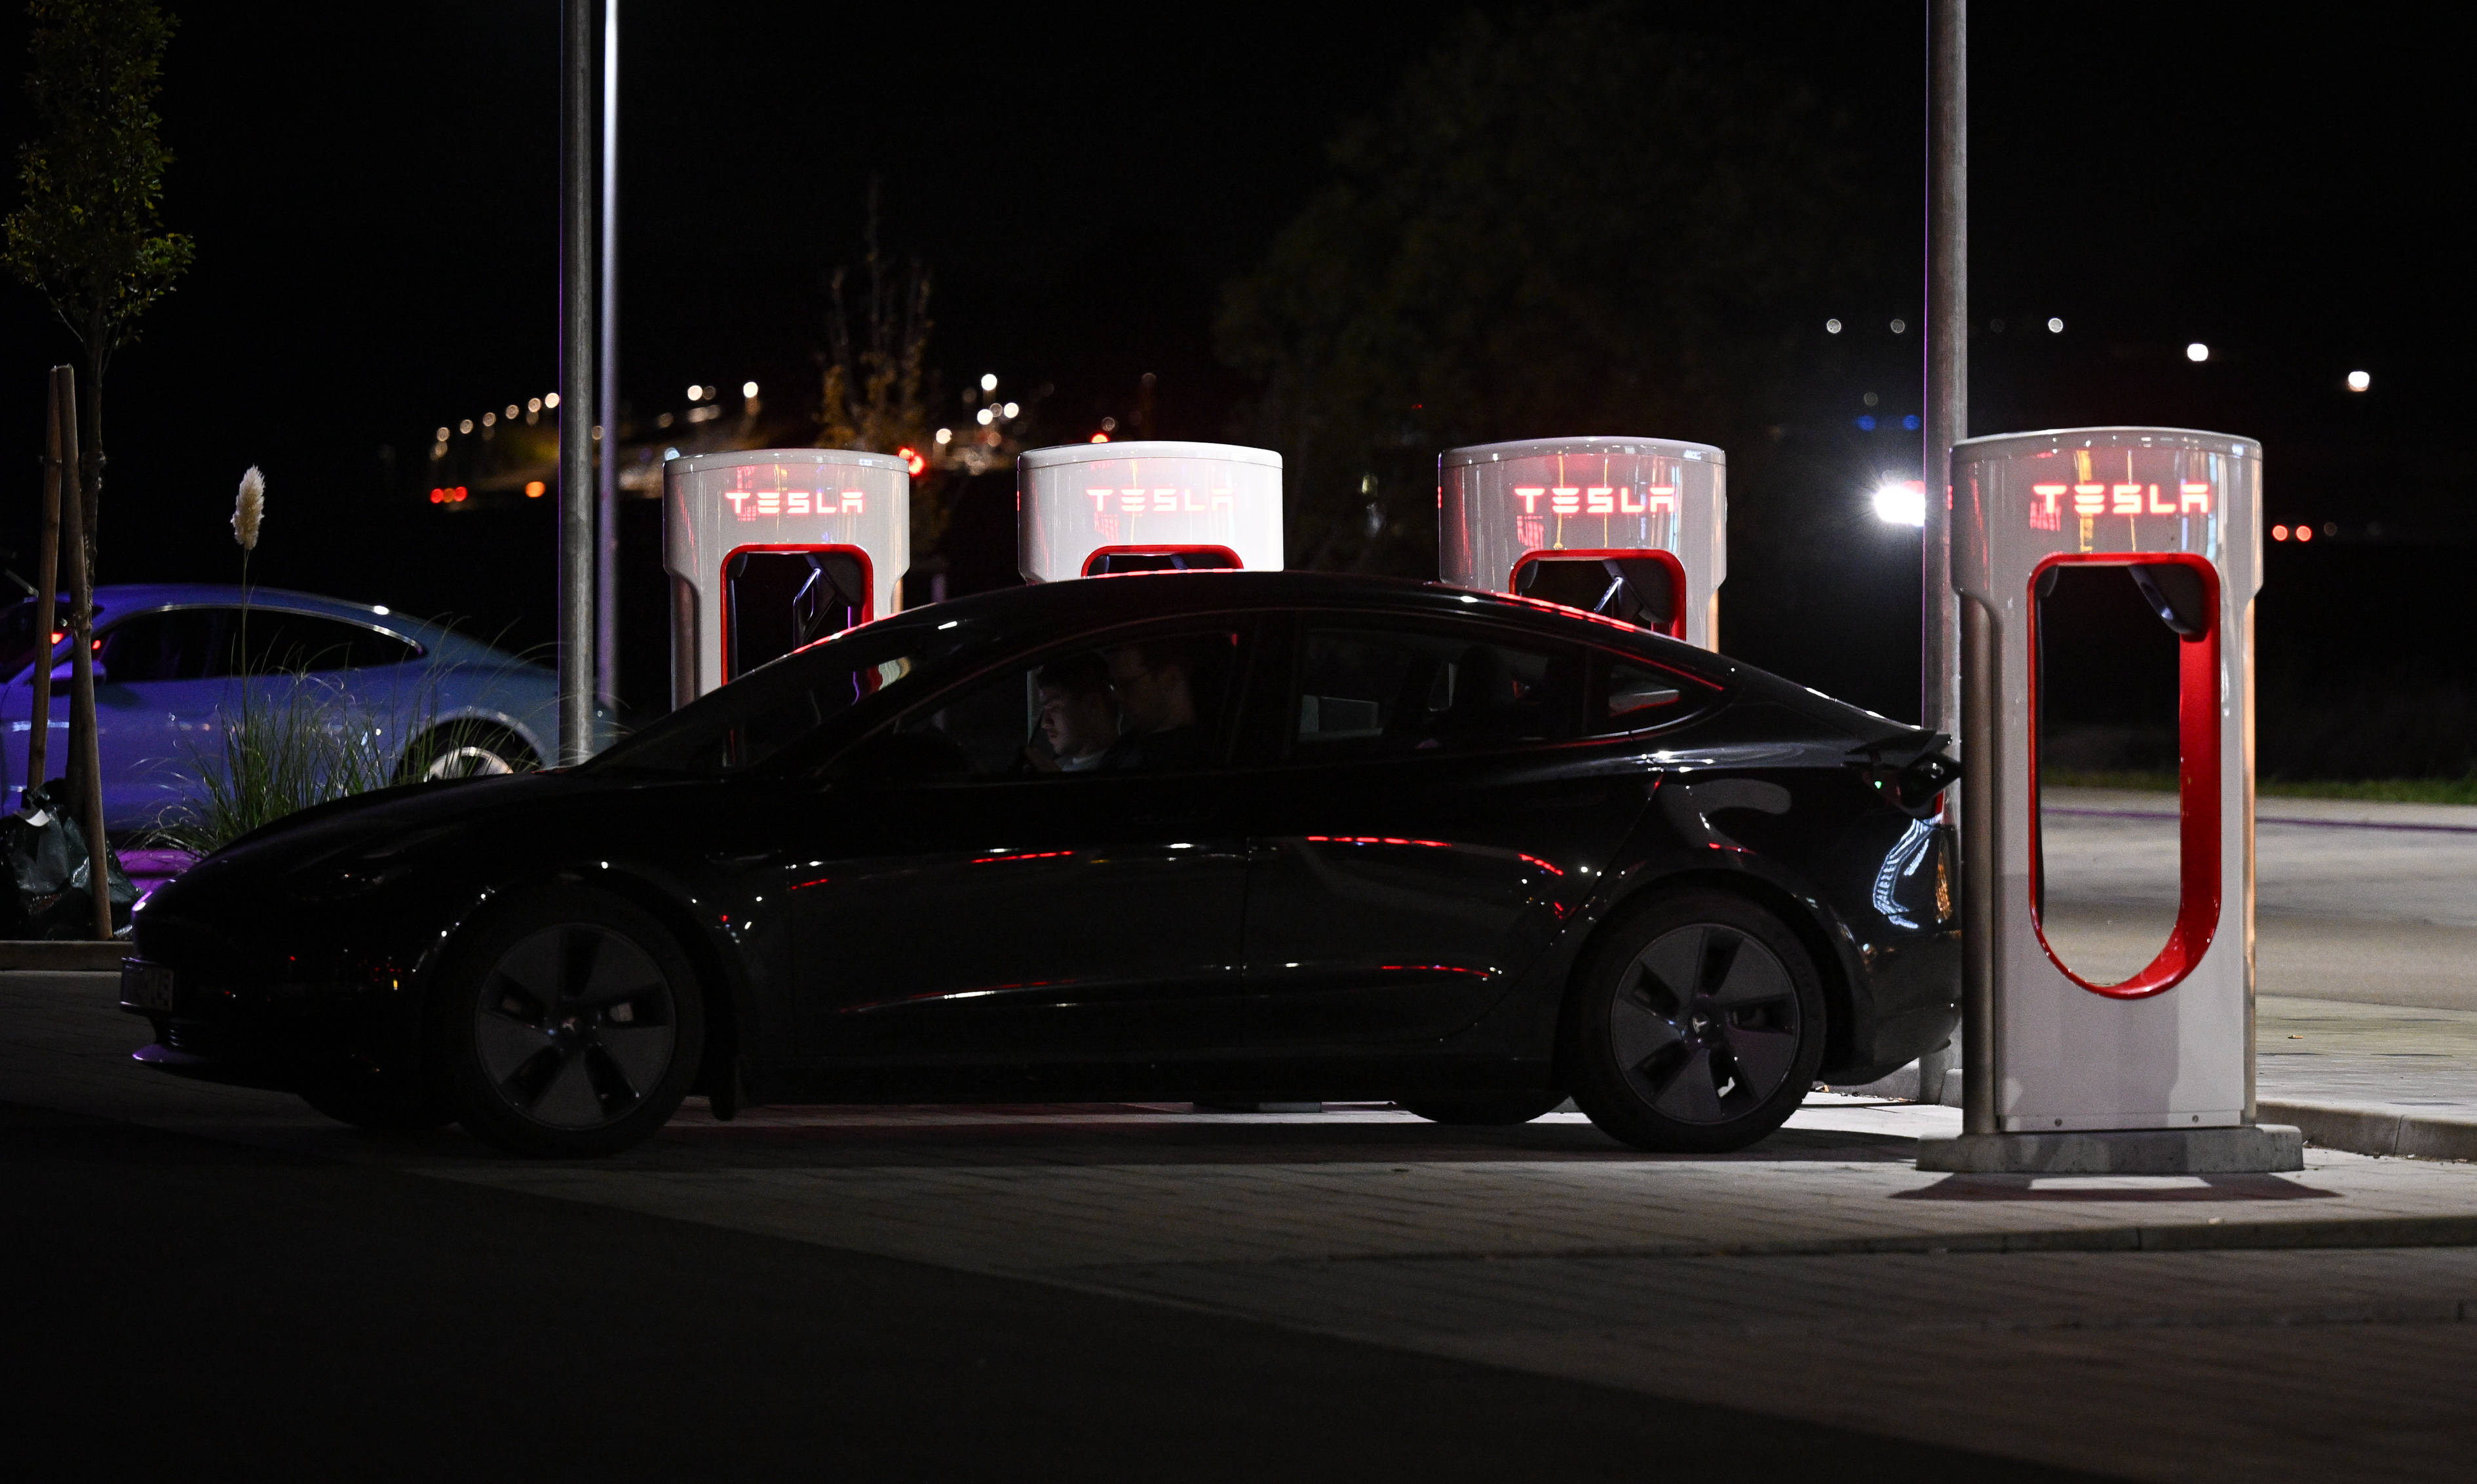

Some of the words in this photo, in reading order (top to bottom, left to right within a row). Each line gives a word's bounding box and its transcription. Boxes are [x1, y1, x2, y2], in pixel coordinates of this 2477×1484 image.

[725, 491, 864, 514] TESLA
[1086, 489, 1235, 512] TESLA
[1514, 487, 1675, 513] TESLA
[2033, 484, 2209, 514] TESLA
